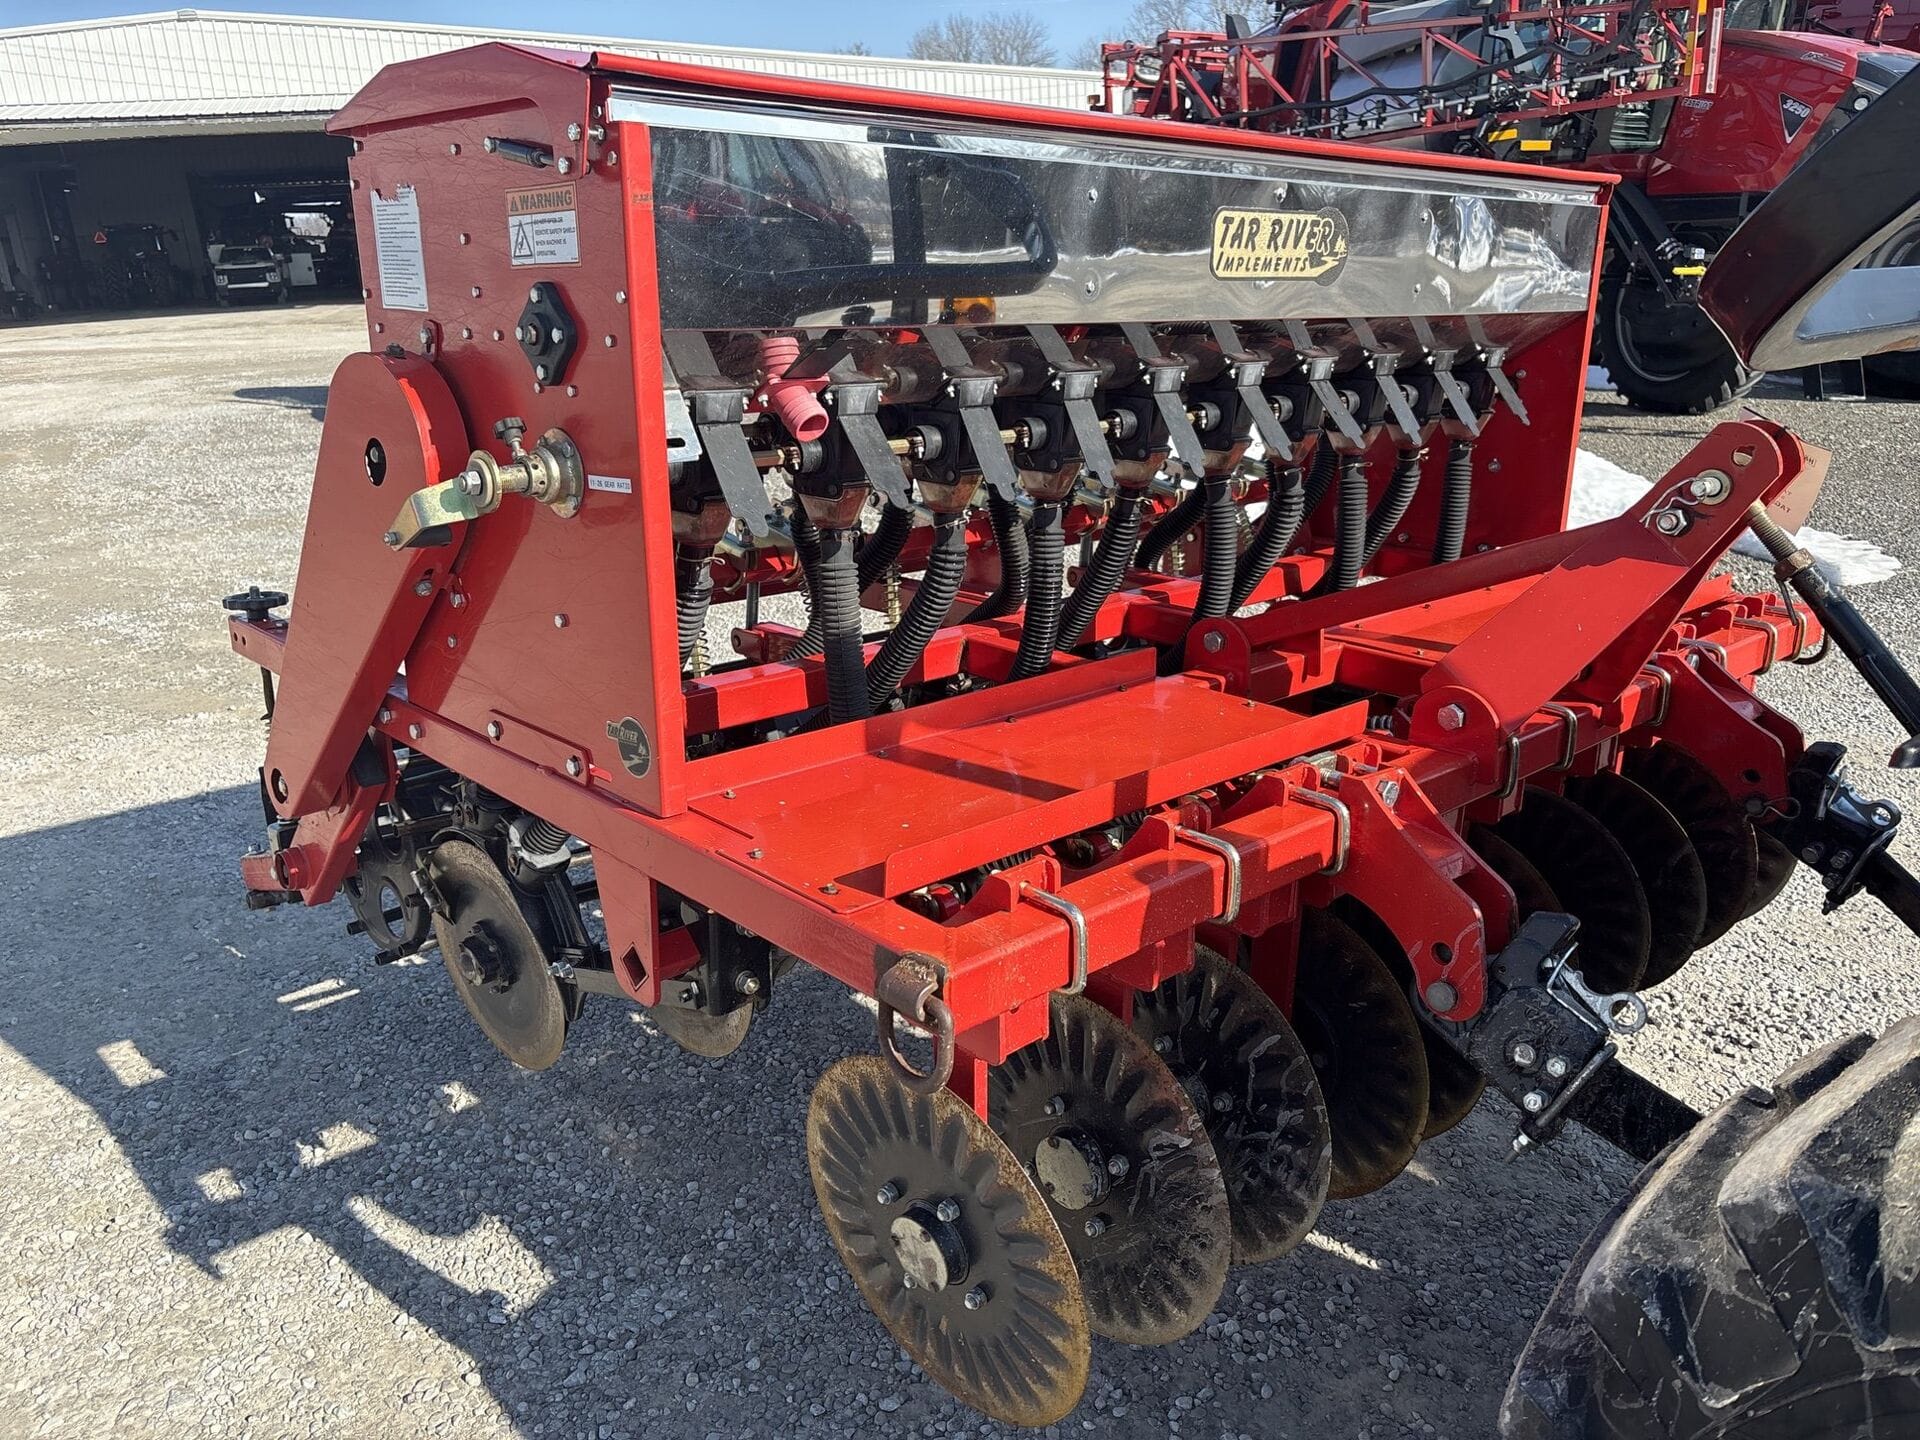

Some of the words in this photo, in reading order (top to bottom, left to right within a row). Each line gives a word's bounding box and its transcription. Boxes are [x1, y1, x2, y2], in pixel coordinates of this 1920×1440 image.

[1681, 98, 1714, 110] PATRIOT
[1782, 99, 1811, 118] 3250
[519, 190, 573, 210] WARNING
[1219, 216, 1261, 252] TAR
[1266, 217, 1335, 255] RIVER
[1215, 251, 1309, 273] IMPLEMENTS
[604, 480, 615, 488] GEAR
[616, 481, 630, 489] RATIO
[607, 723, 618, 737] TAR
[619, 726, 638, 743] RIVER
